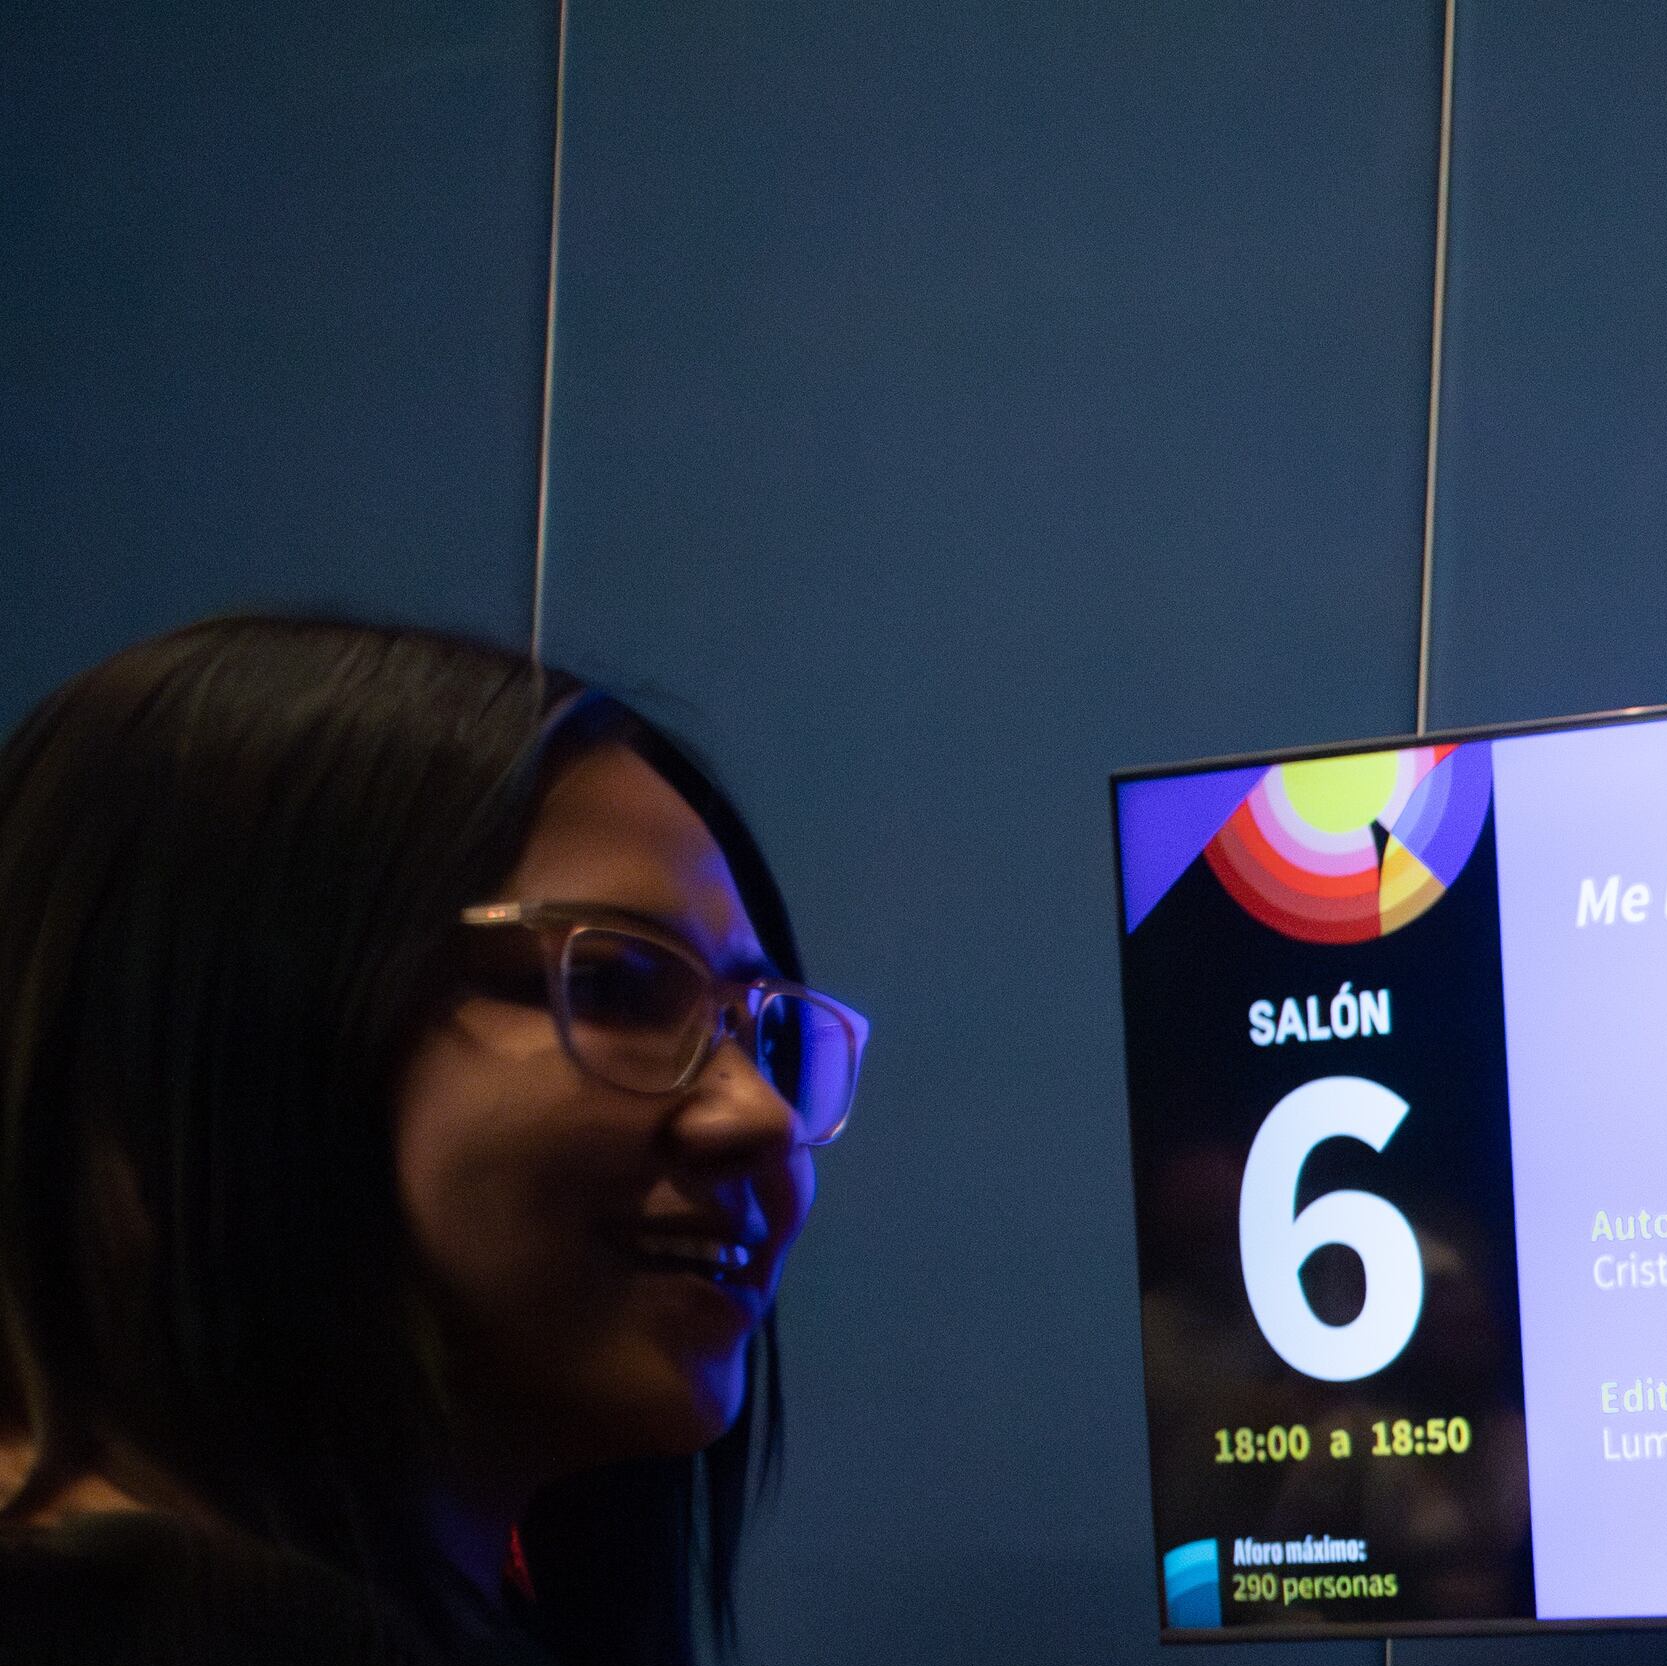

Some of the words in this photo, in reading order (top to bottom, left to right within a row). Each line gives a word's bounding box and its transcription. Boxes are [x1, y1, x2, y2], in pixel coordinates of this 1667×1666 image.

[1576, 875, 1651, 929] Me
[1248, 981, 1391, 1046] SALÓN
[1239, 1075, 1424, 1382] 6
[1214, 1424, 1311, 1463] 18:00
[1329, 1429, 1352, 1459] a
[1371, 1416, 1471, 1456] 18:50
[1233, 1536, 1284, 1566] Aforo
[1285, 1533, 1367, 1564] máximo:
[1232, 1572, 1279, 1602] 290
[1282, 1573, 1398, 1606] personas
